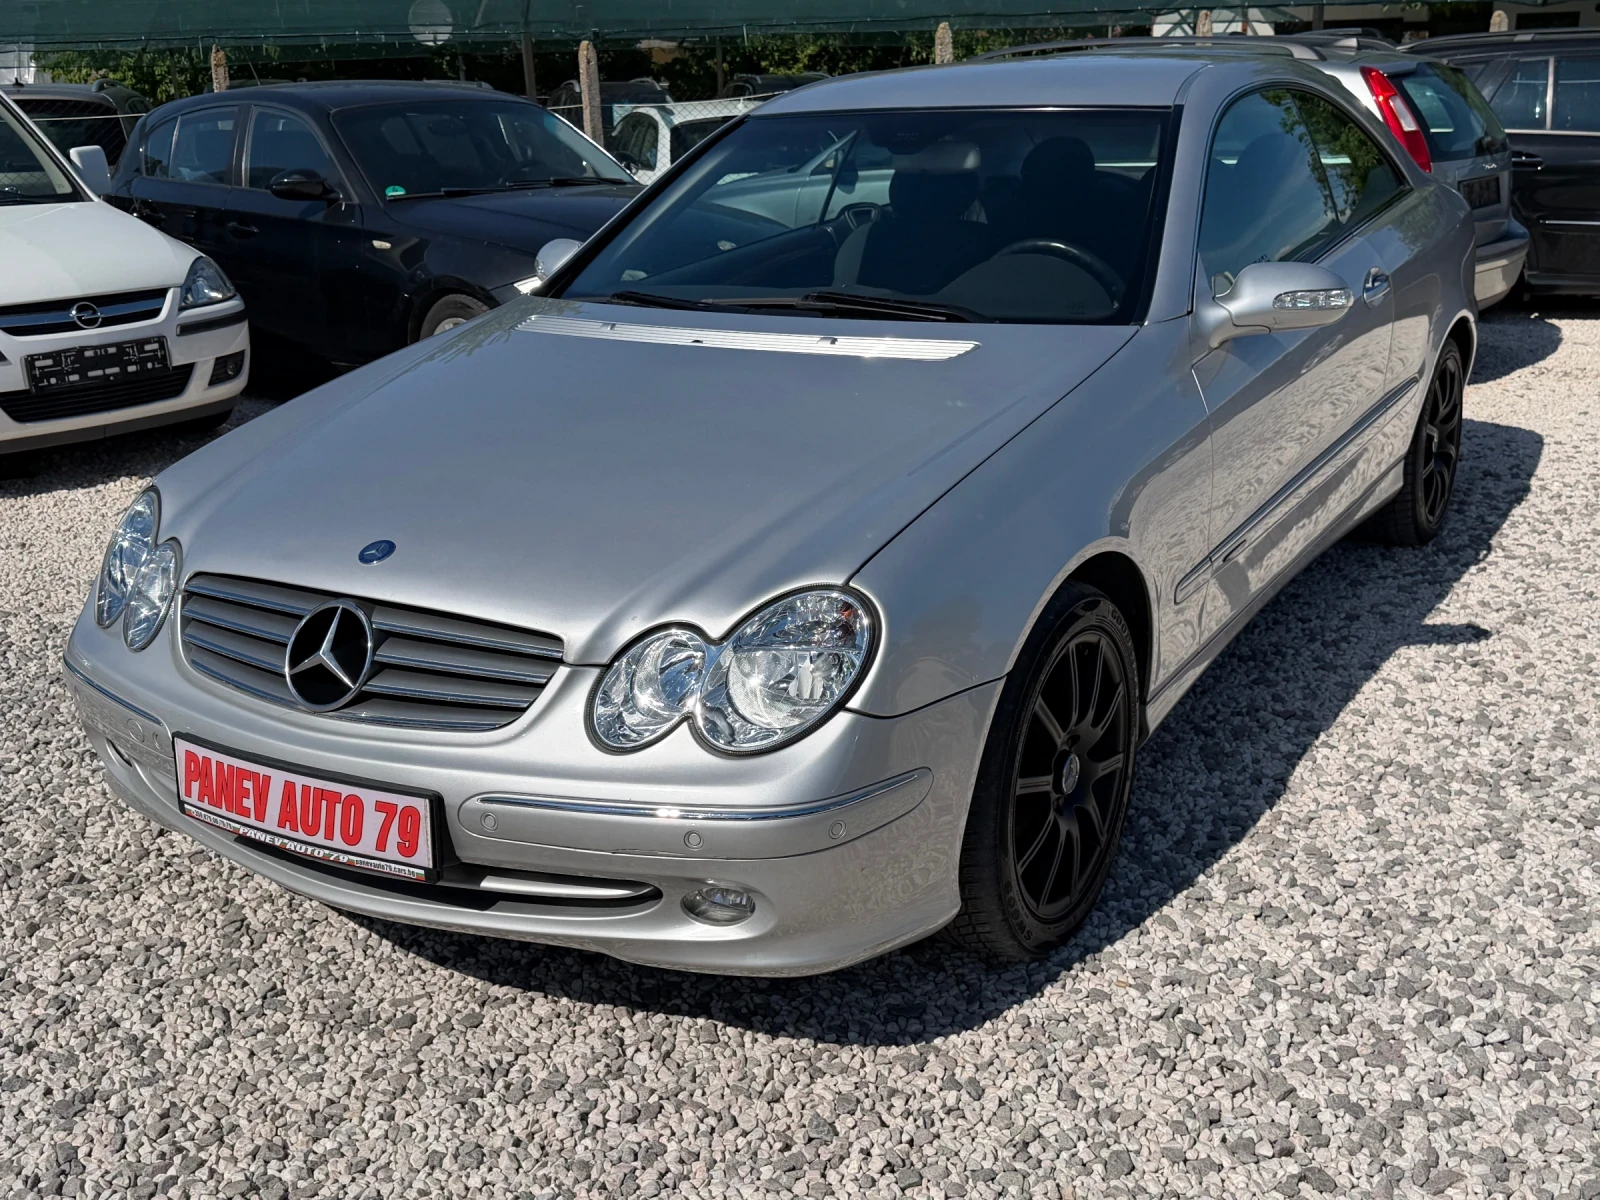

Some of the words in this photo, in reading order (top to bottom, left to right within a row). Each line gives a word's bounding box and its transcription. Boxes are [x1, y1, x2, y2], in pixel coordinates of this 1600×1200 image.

[184, 749, 271, 823] PANEV
[277, 779, 364, 847] AUTO
[374, 800, 421, 858] 79
[239, 826, 282, 846] PANEV
[286, 841, 324, 858] AUTO
[328, 850, 350, 863] 79
